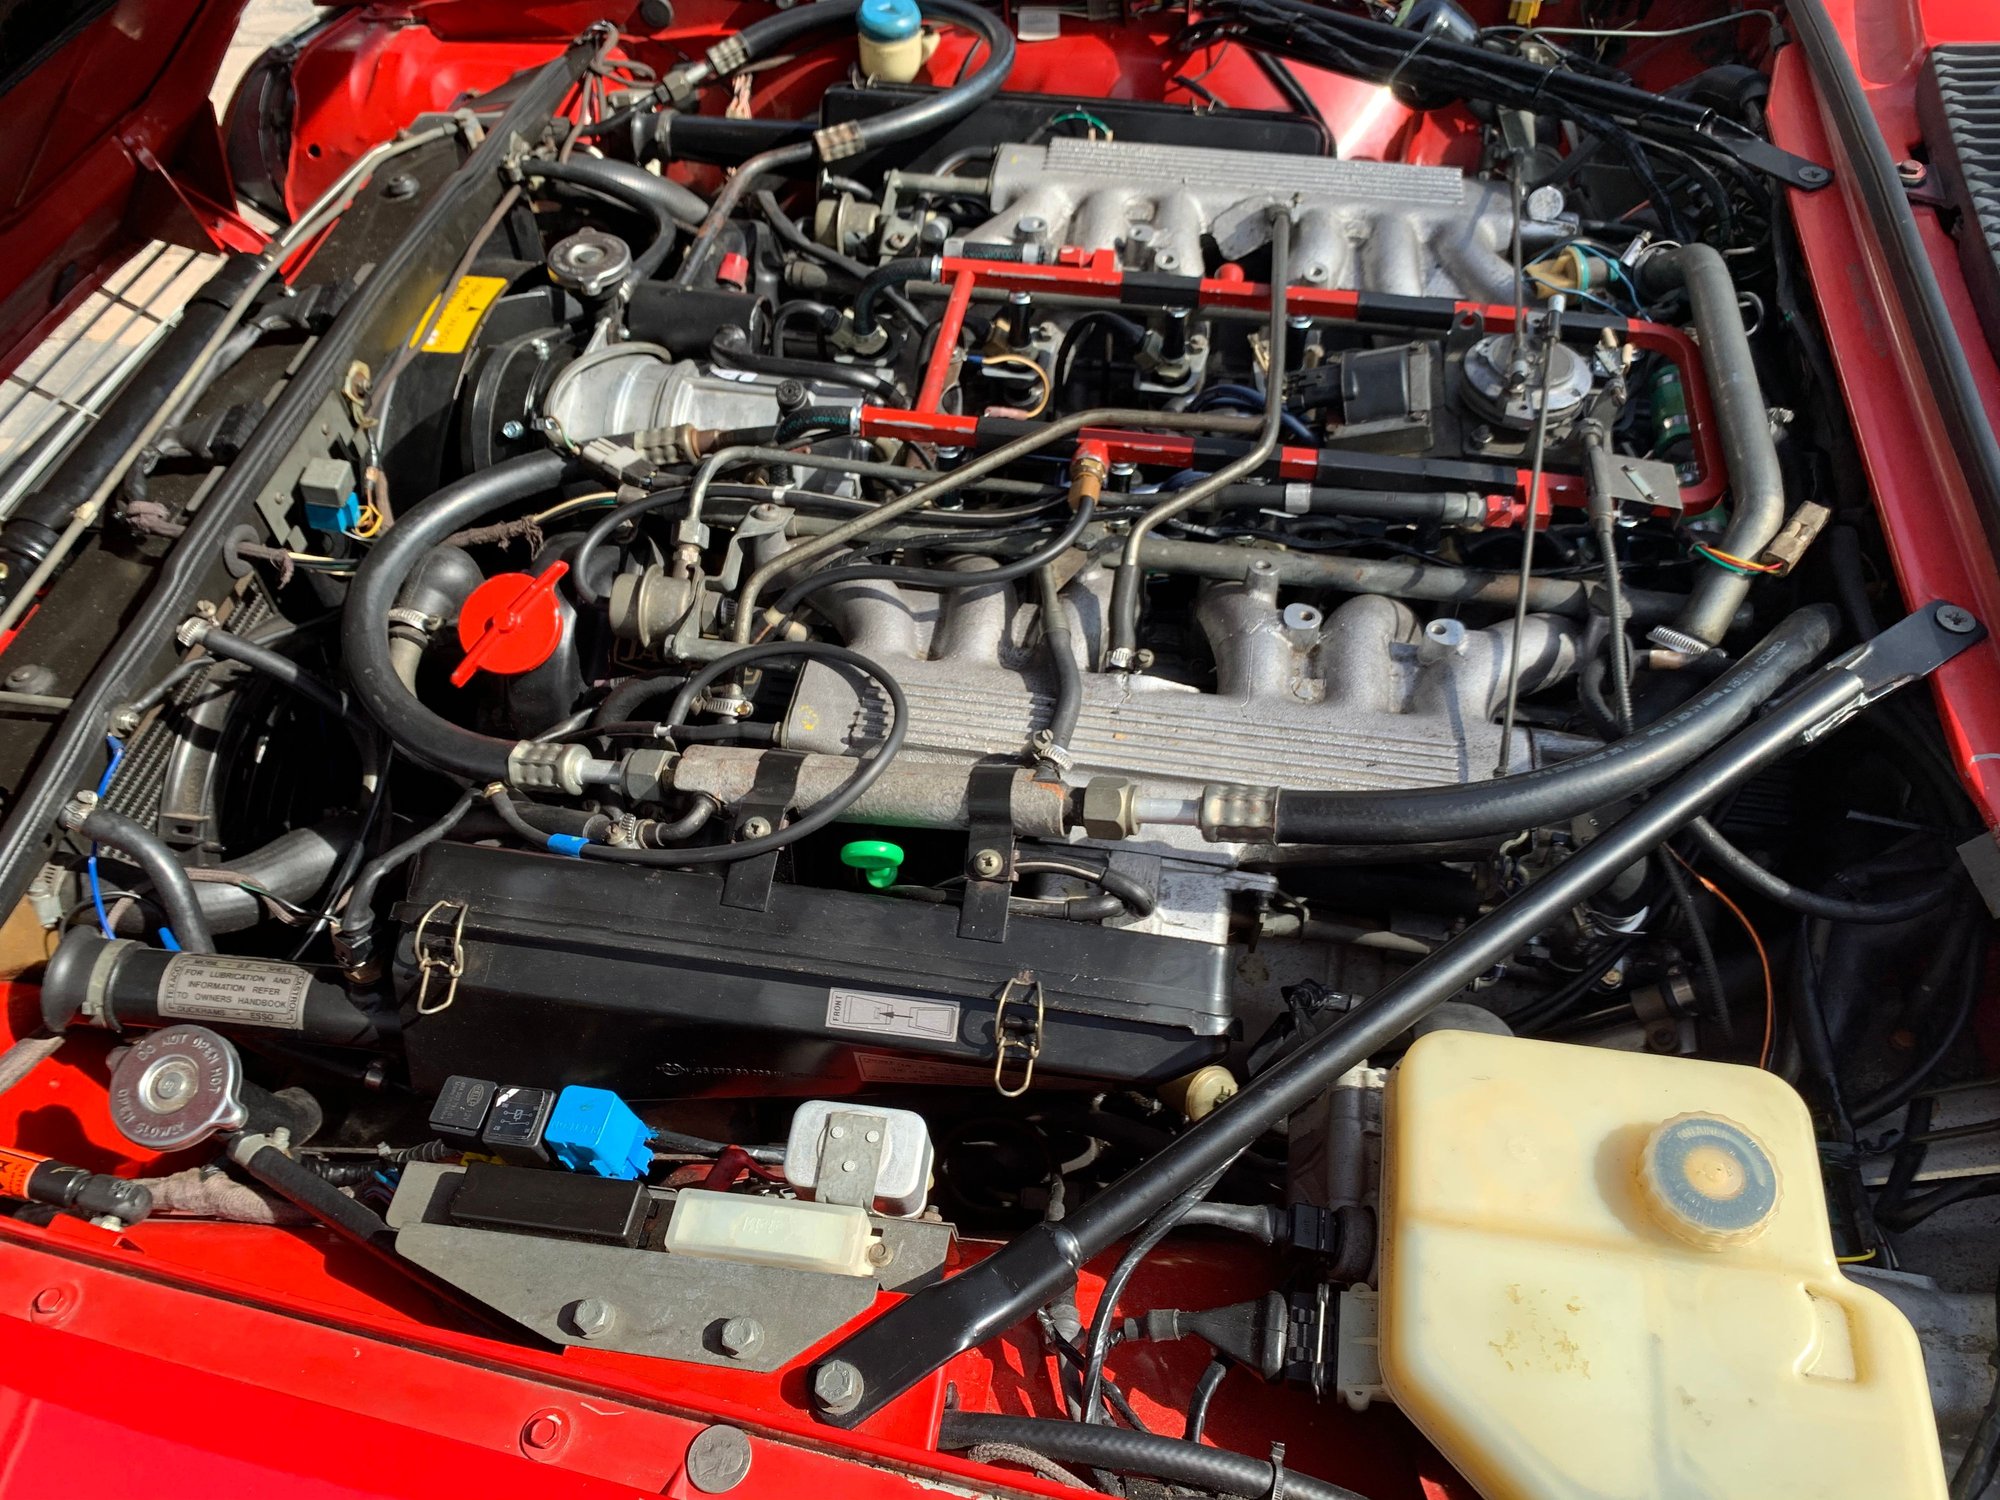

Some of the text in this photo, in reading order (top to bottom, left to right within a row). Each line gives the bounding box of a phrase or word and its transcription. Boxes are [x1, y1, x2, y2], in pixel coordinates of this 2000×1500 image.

[166, 966, 181, 999] TEXACO
[188, 981, 280, 996] INFORMATION REFER
[209, 971, 266, 983] LUBRICATION
[272, 977, 291, 985] AND
[194, 993, 232, 1004] OWNERS
[237, 997, 287, 1009] HANDBOOK
[288, 974, 303, 1014] CASTROL
[177, 1005, 274, 1021] DUCKHAMS ESSO
[832, 995, 843, 1022] FRONT
[192, 1036, 220, 1064] OPEN
[208, 1067, 223, 1094] HOT
